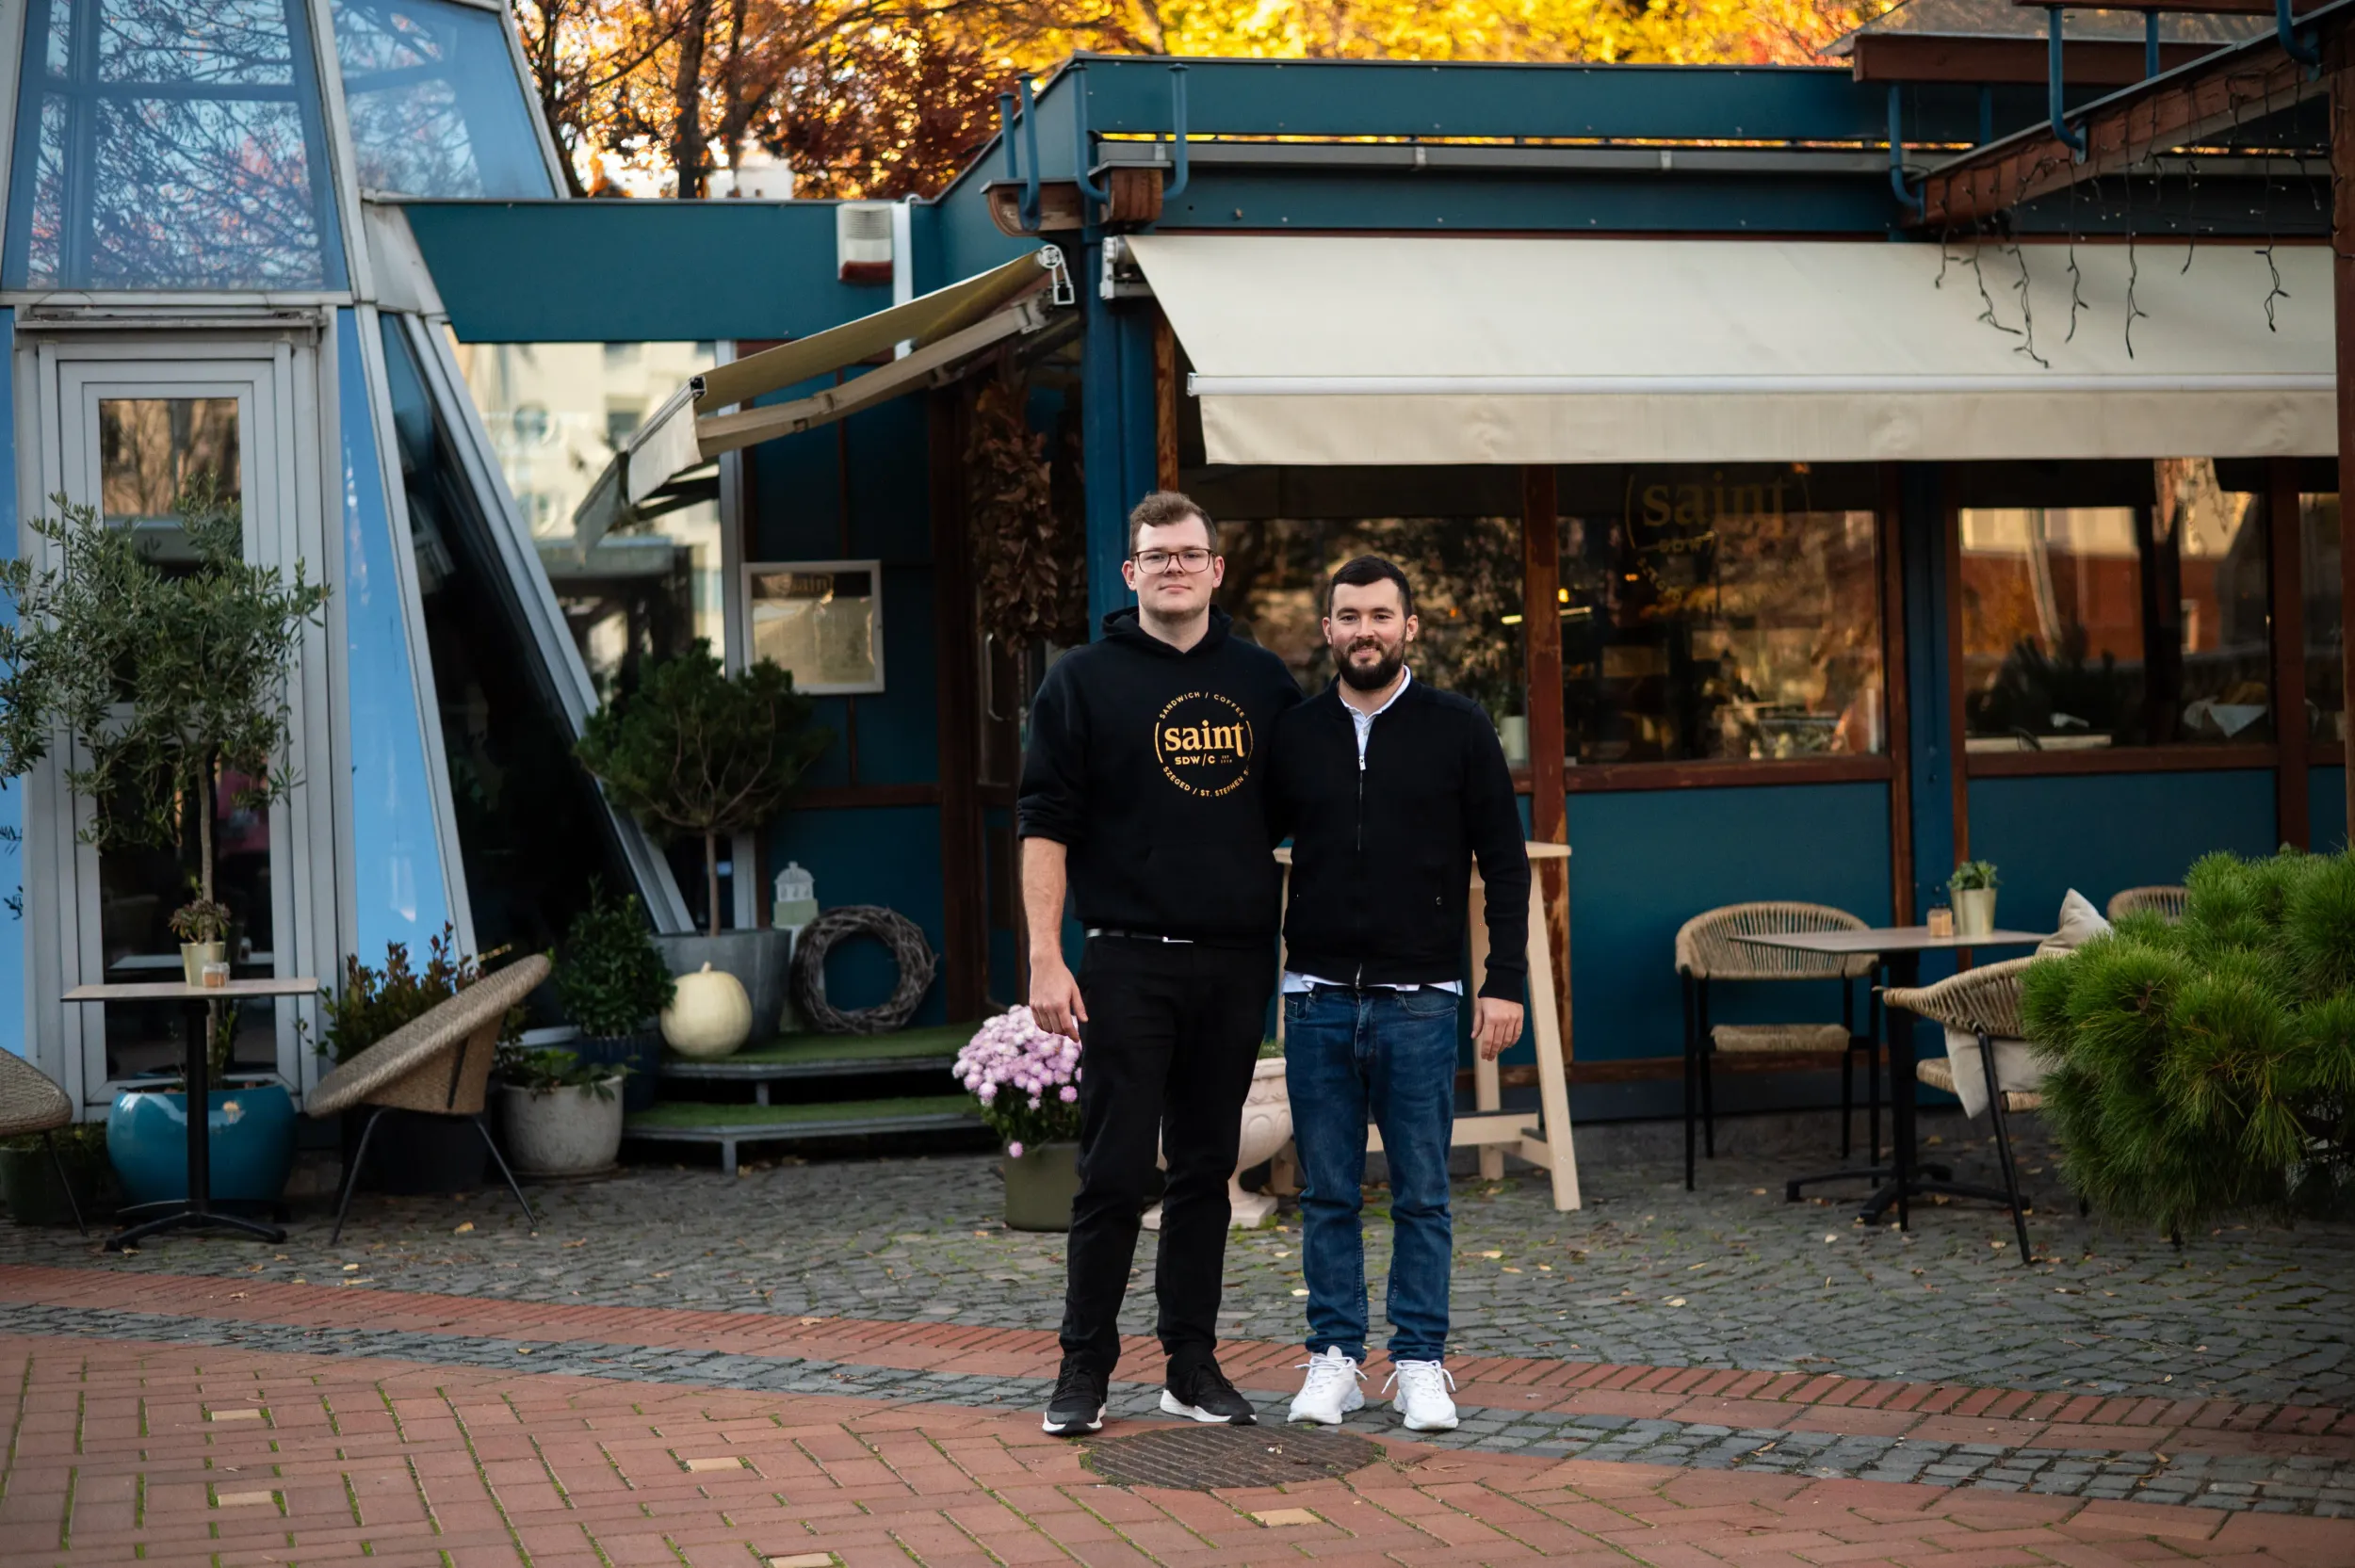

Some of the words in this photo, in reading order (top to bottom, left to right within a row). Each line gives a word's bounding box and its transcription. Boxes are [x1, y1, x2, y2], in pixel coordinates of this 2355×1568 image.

[1642, 471, 1791, 539] saint
[1160, 691, 1200, 719] SANDWICH
[1213, 694, 1245, 718] COFFEE
[1164, 719, 1245, 757] saint
[1175, 753, 1216, 767] SDW/C
[1162, 766, 1191, 791] SZEGED
[1214, 776, 1244, 797] STEPHEN
